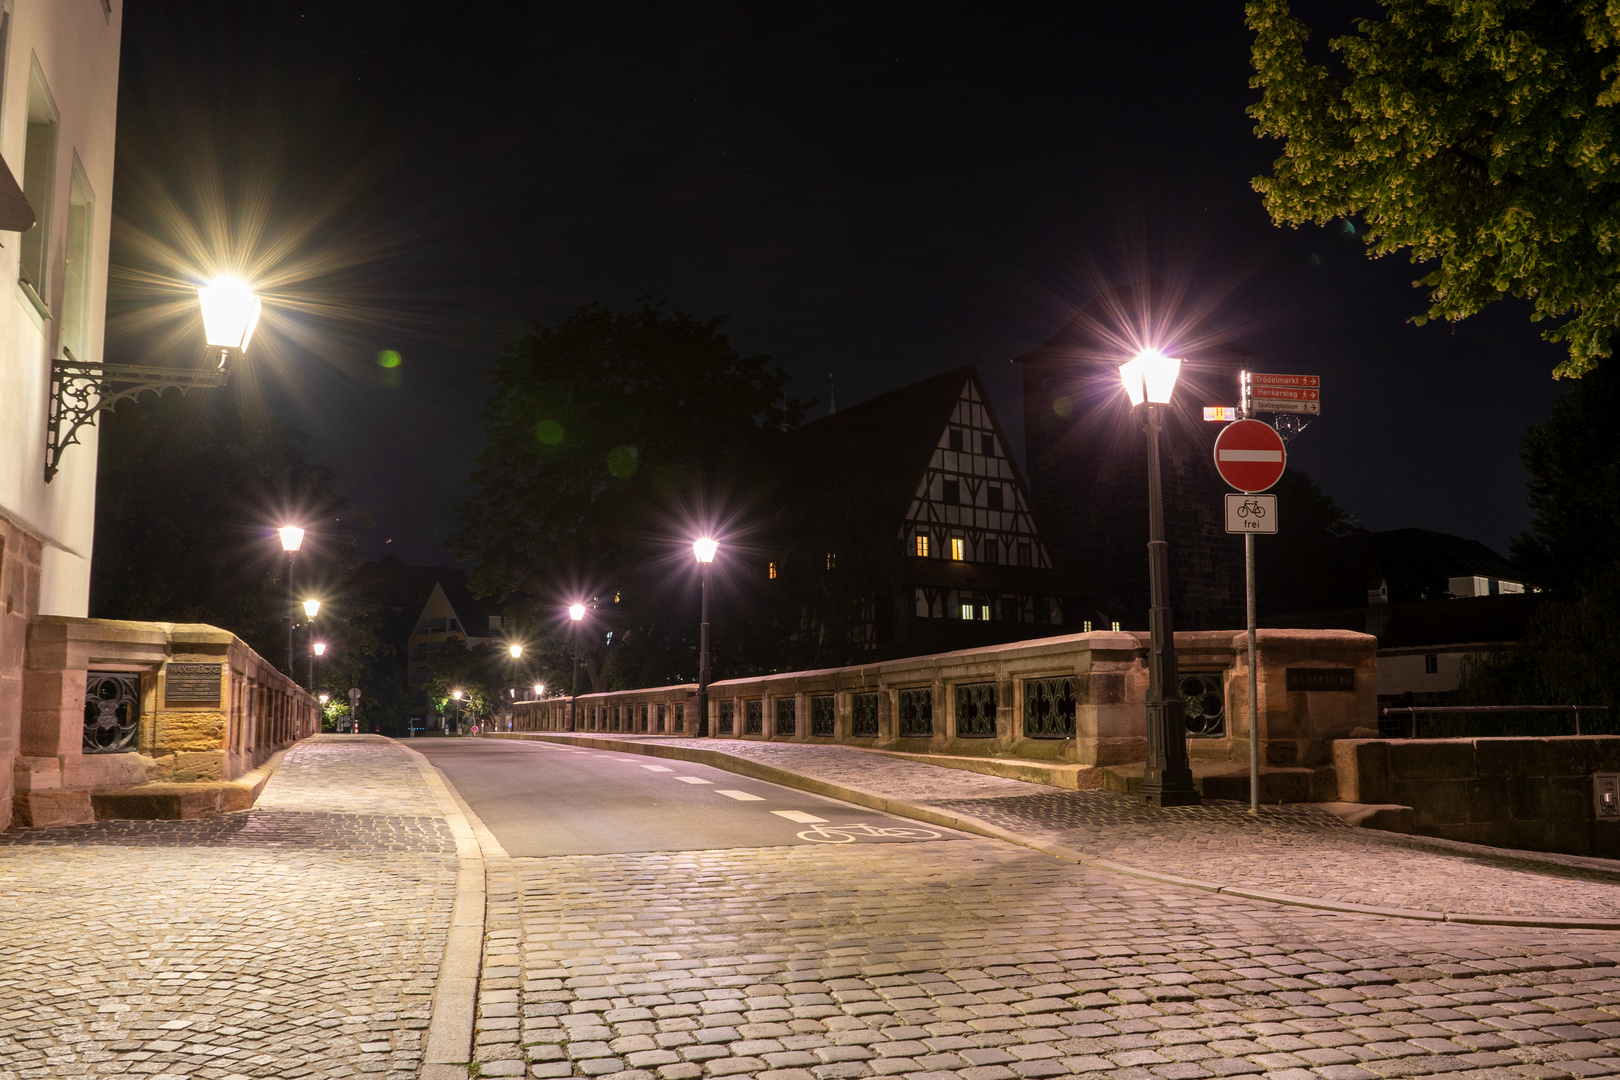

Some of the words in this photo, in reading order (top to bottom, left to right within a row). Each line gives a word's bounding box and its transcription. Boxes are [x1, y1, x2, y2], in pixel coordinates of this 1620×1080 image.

[1255, 375, 1299, 385] Trödelmarkt
[1257, 388, 1298, 399] Henkersteg
[1257, 401, 1299, 410] Spielzeugmuseum
[1244, 520, 1260, 528] frei
[169, 664, 221, 675] MAXBRÜCKE
